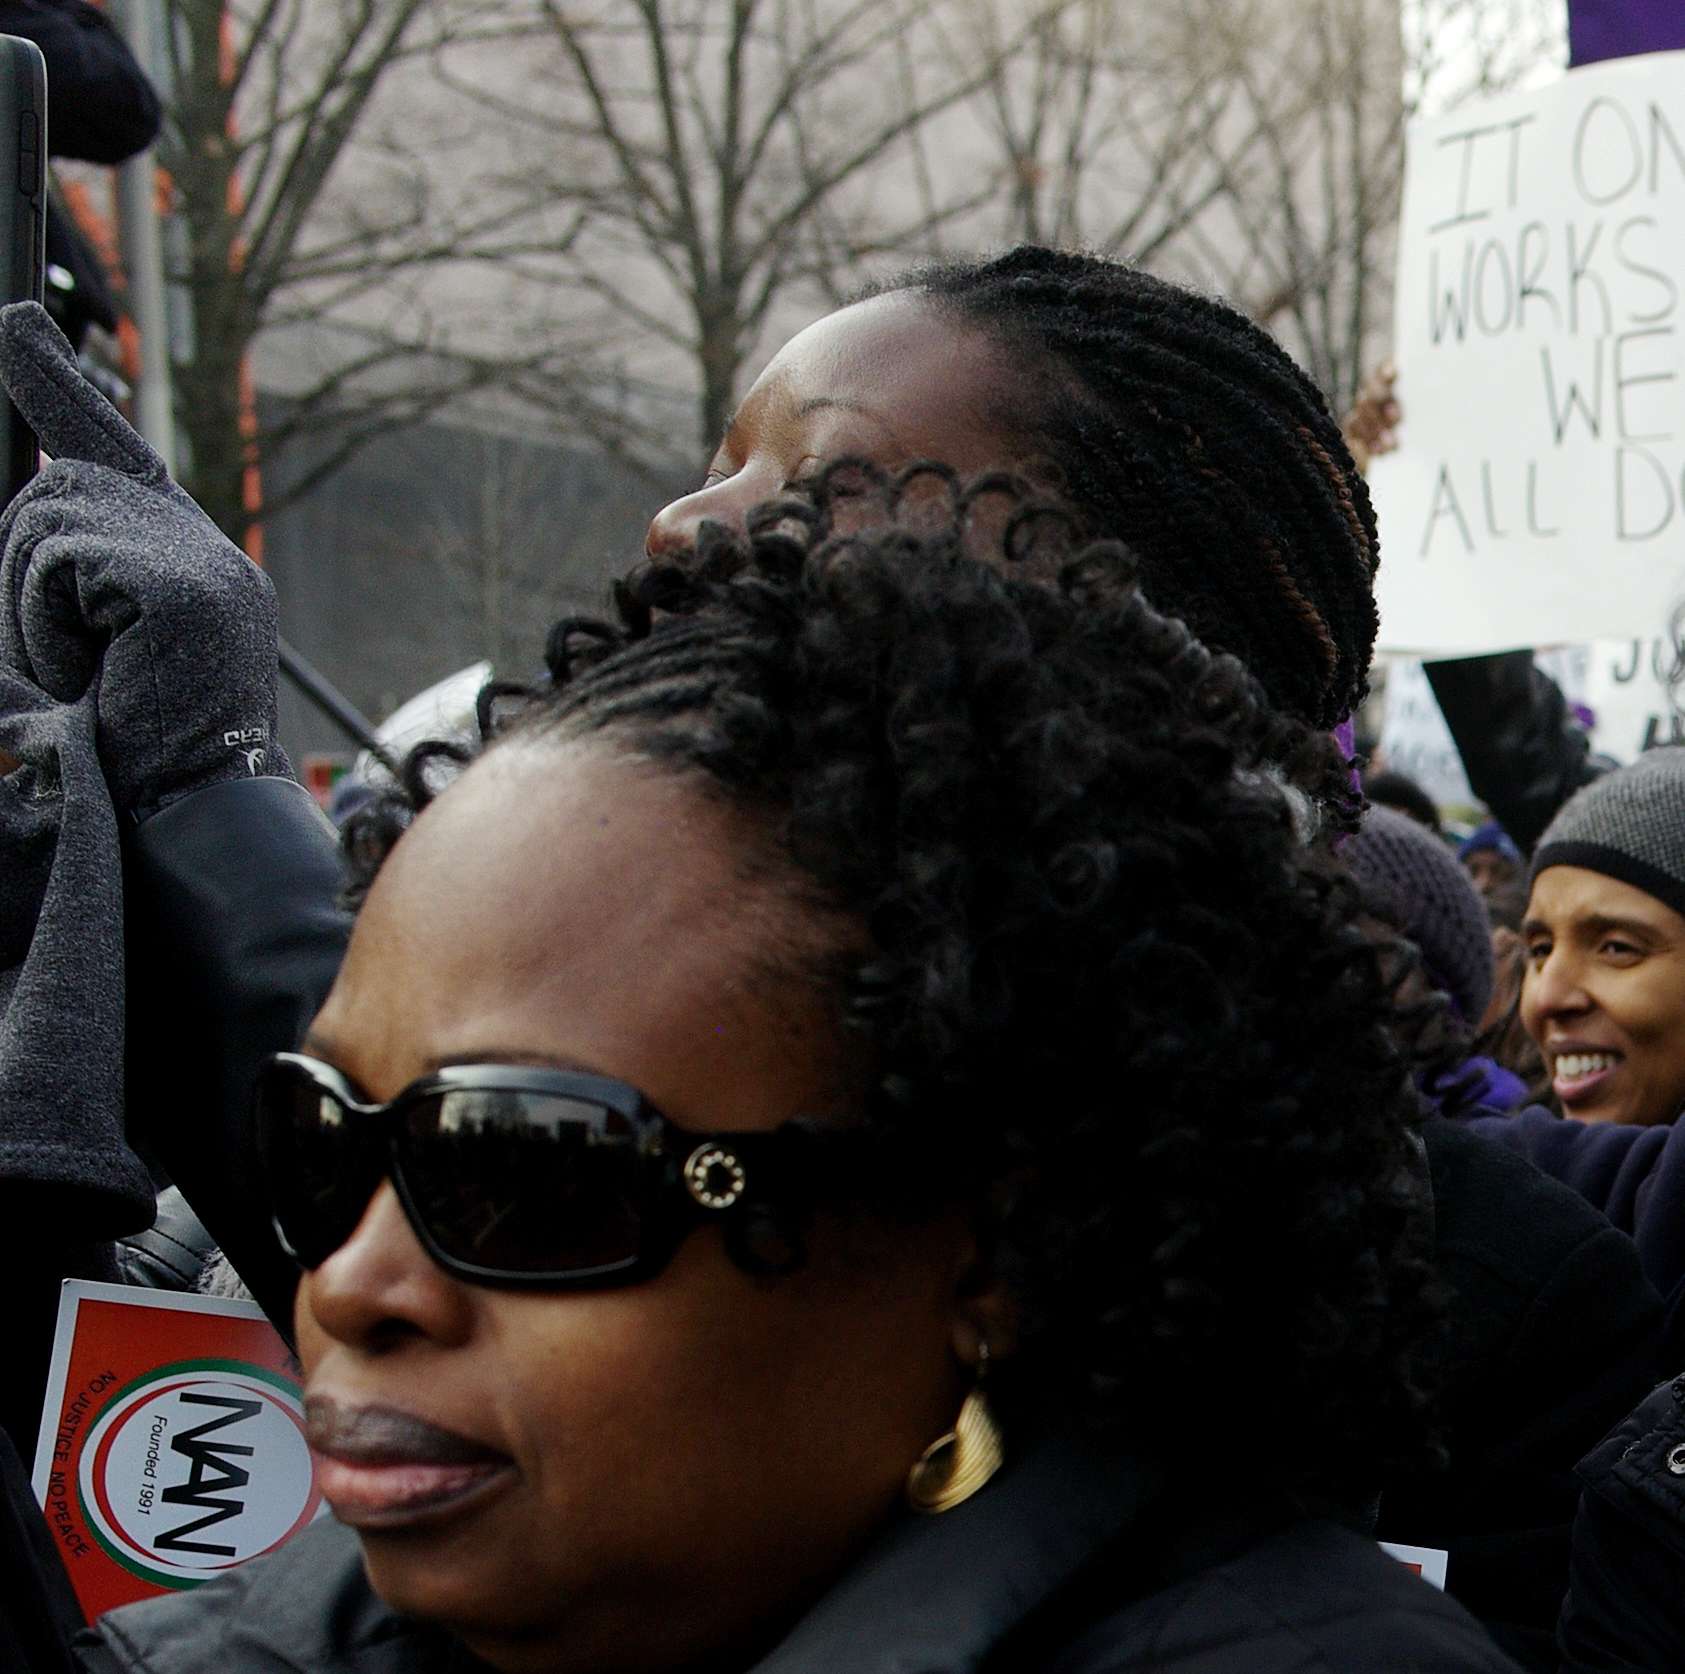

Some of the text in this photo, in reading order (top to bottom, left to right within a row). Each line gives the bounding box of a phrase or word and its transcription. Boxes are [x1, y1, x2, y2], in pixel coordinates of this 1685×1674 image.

[1428, 112, 1536, 236] IT
[1429, 215, 1681, 346] WORKS
[1541, 326, 1678, 448] WE
[1420, 457, 1562, 560] ALL
[50, 1370, 117, 1558] NO JUSTICE NO PEACE
[137, 1415, 168, 1515] Founded 1991
[153, 1392, 263, 1557] NAN
